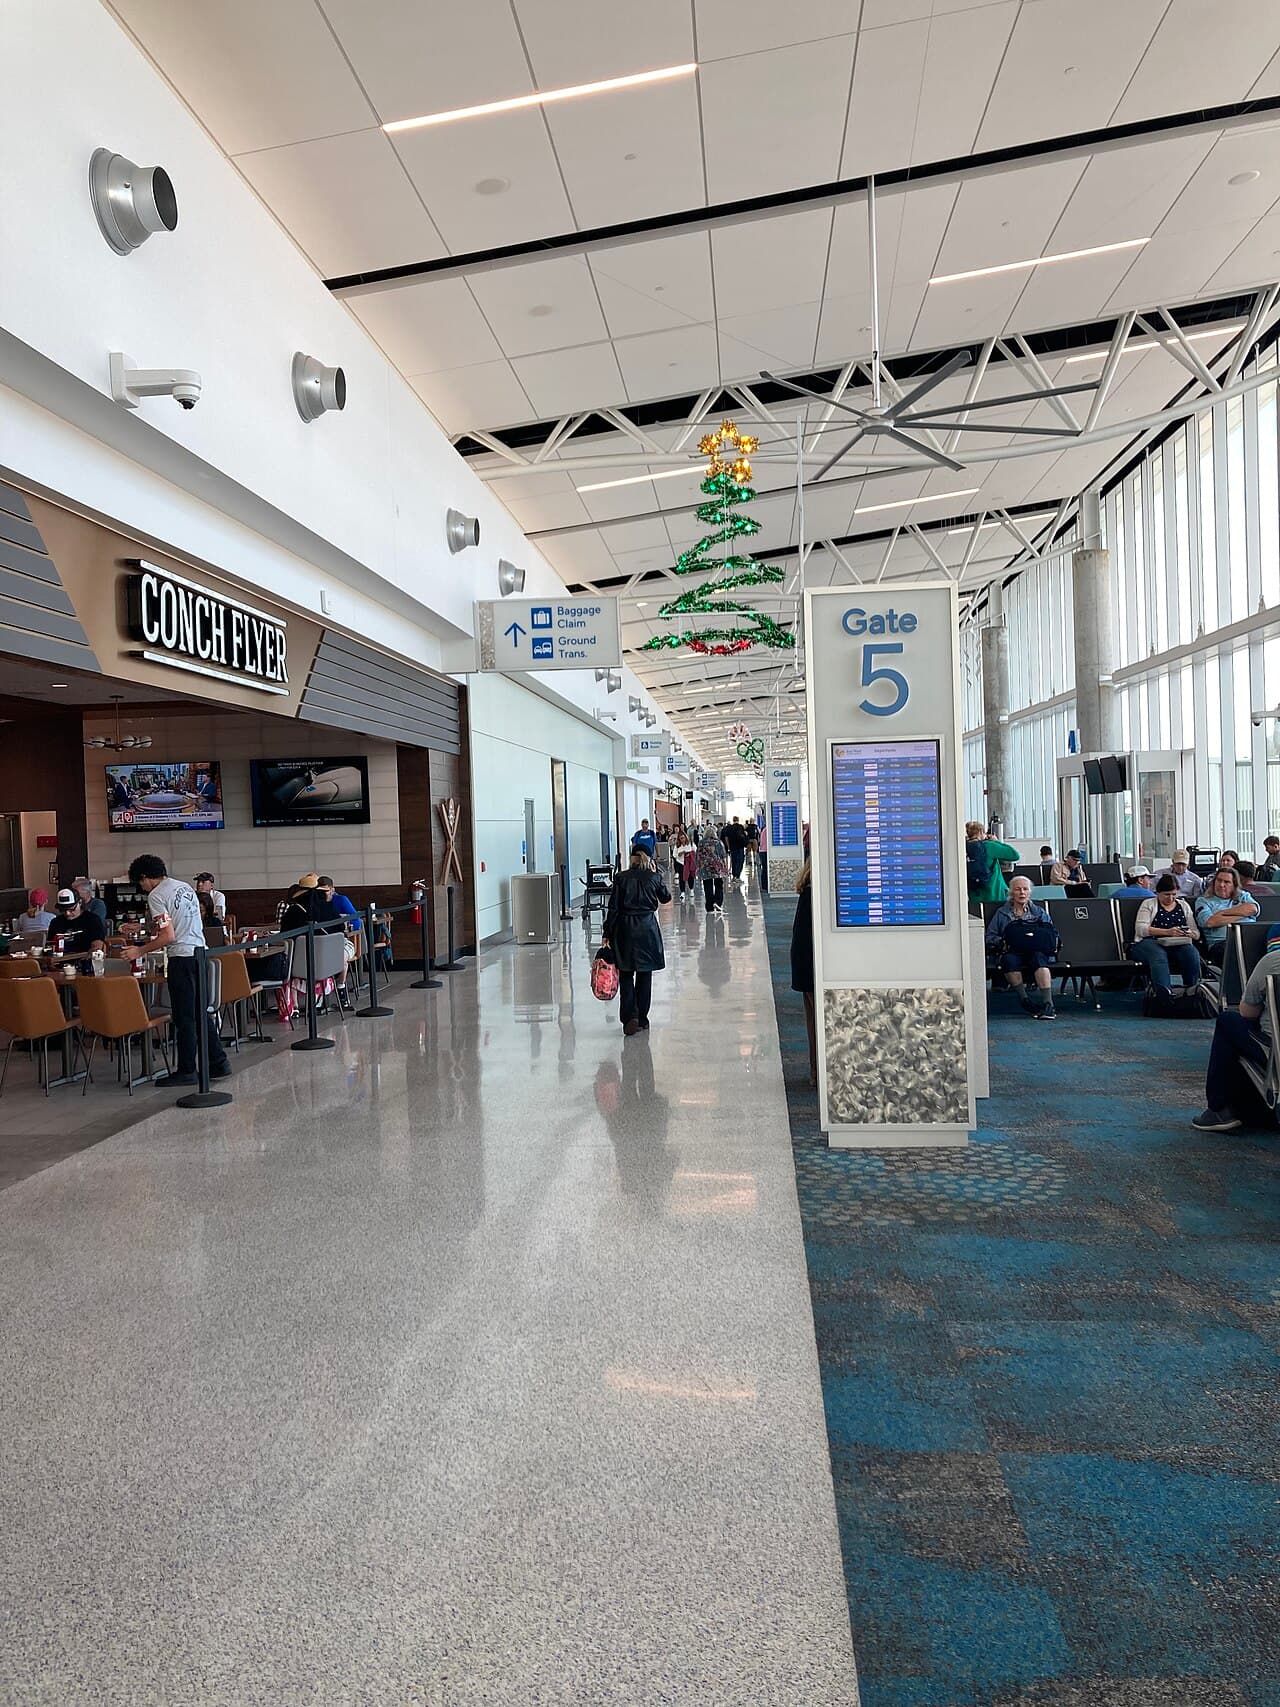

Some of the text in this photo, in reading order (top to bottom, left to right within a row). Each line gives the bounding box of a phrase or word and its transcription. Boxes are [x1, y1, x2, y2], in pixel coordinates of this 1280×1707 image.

[557, 606, 601, 618] Baggage
[141, 573, 289, 684] CONCH FLYER
[557, 619, 586, 629] Claim
[842, 608, 918, 636] Gate
[558, 635, 597, 646] Ground
[558, 649, 588, 659] Trans.
[859, 642, 910, 717] 5
[776, 779, 790, 796] 4
